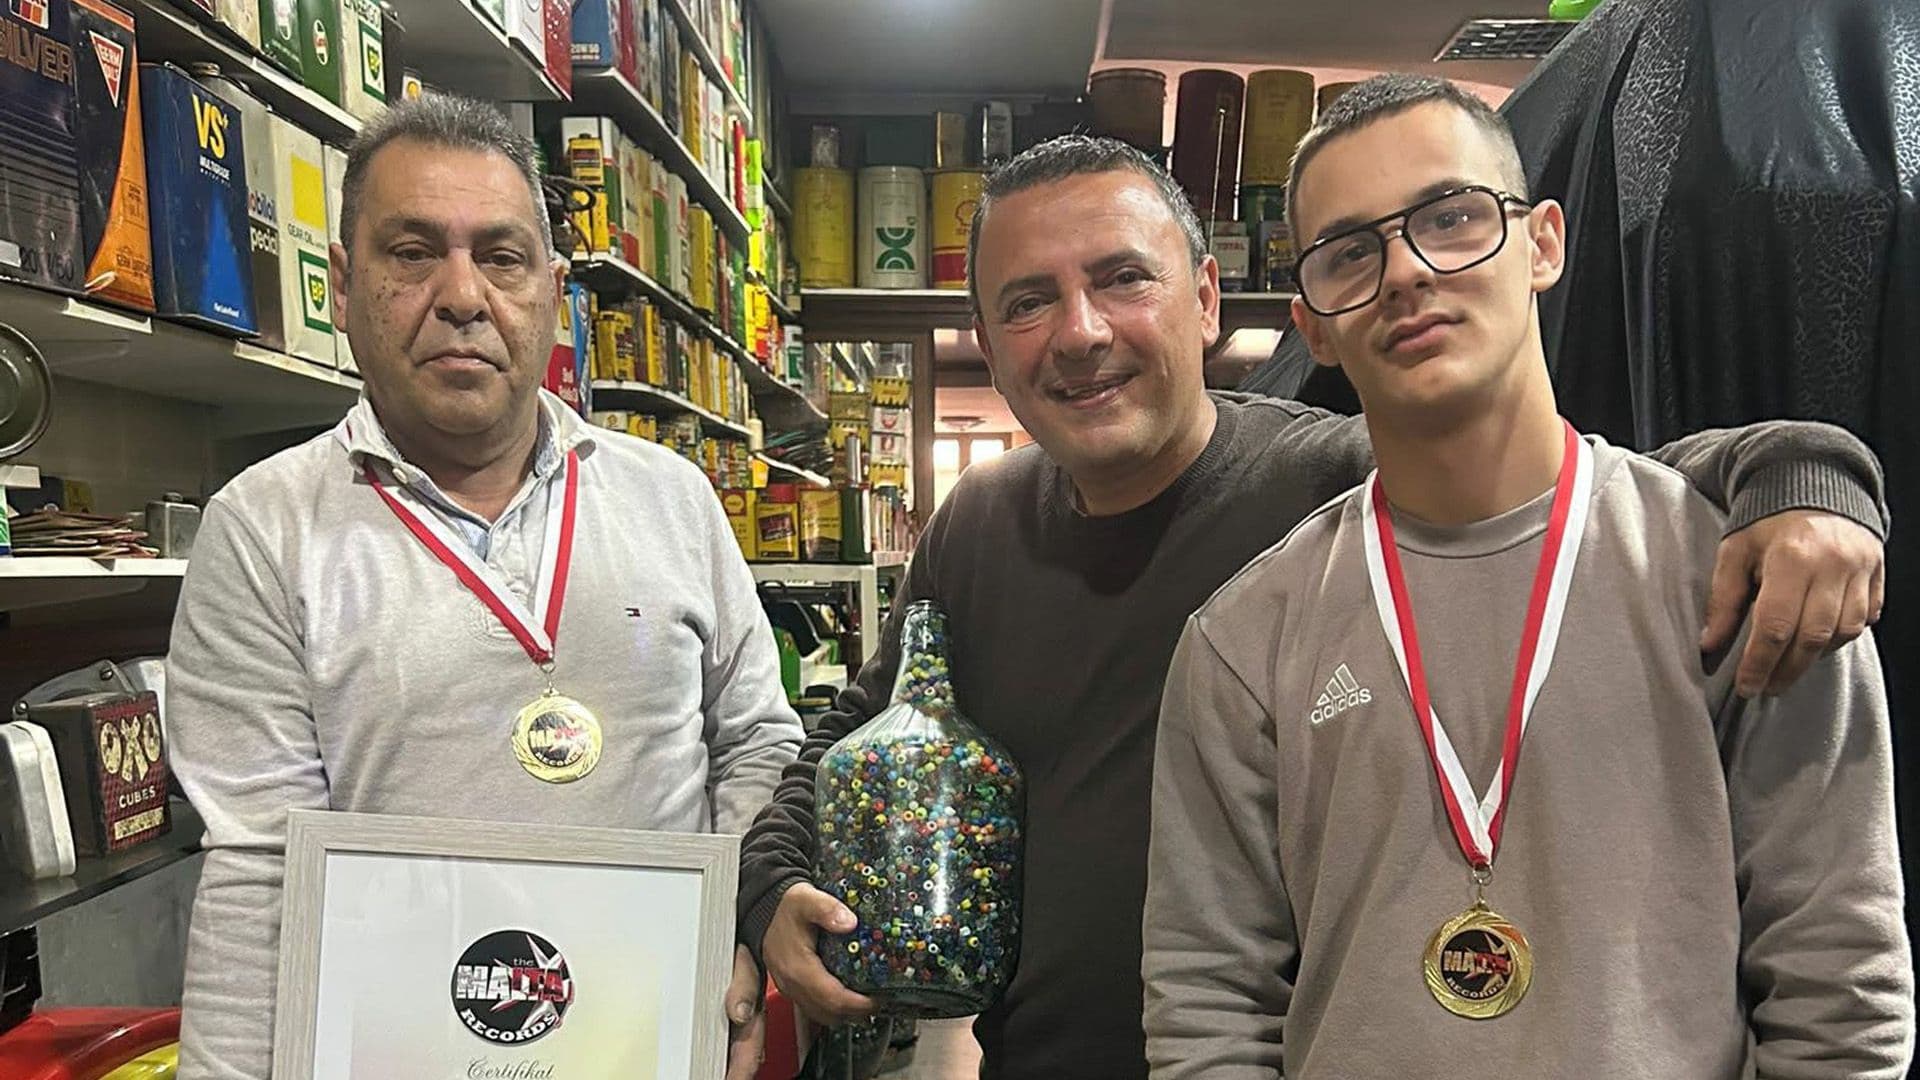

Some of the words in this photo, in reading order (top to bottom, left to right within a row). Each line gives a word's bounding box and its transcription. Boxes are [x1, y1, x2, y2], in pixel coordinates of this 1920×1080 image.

[249, 226, 279, 256] pecial
[1310, 688, 1372, 724] adidas
[101, 713, 160, 783] OXO
[119, 785, 156, 808] CUBES
[513, 958, 534, 967] the
[456, 965, 565, 1001] MALTA
[1446, 977, 1506, 998] RECORDS
[460, 1008, 556, 1042] RECORDS
[467, 1056, 554, 1080] Certifikat
